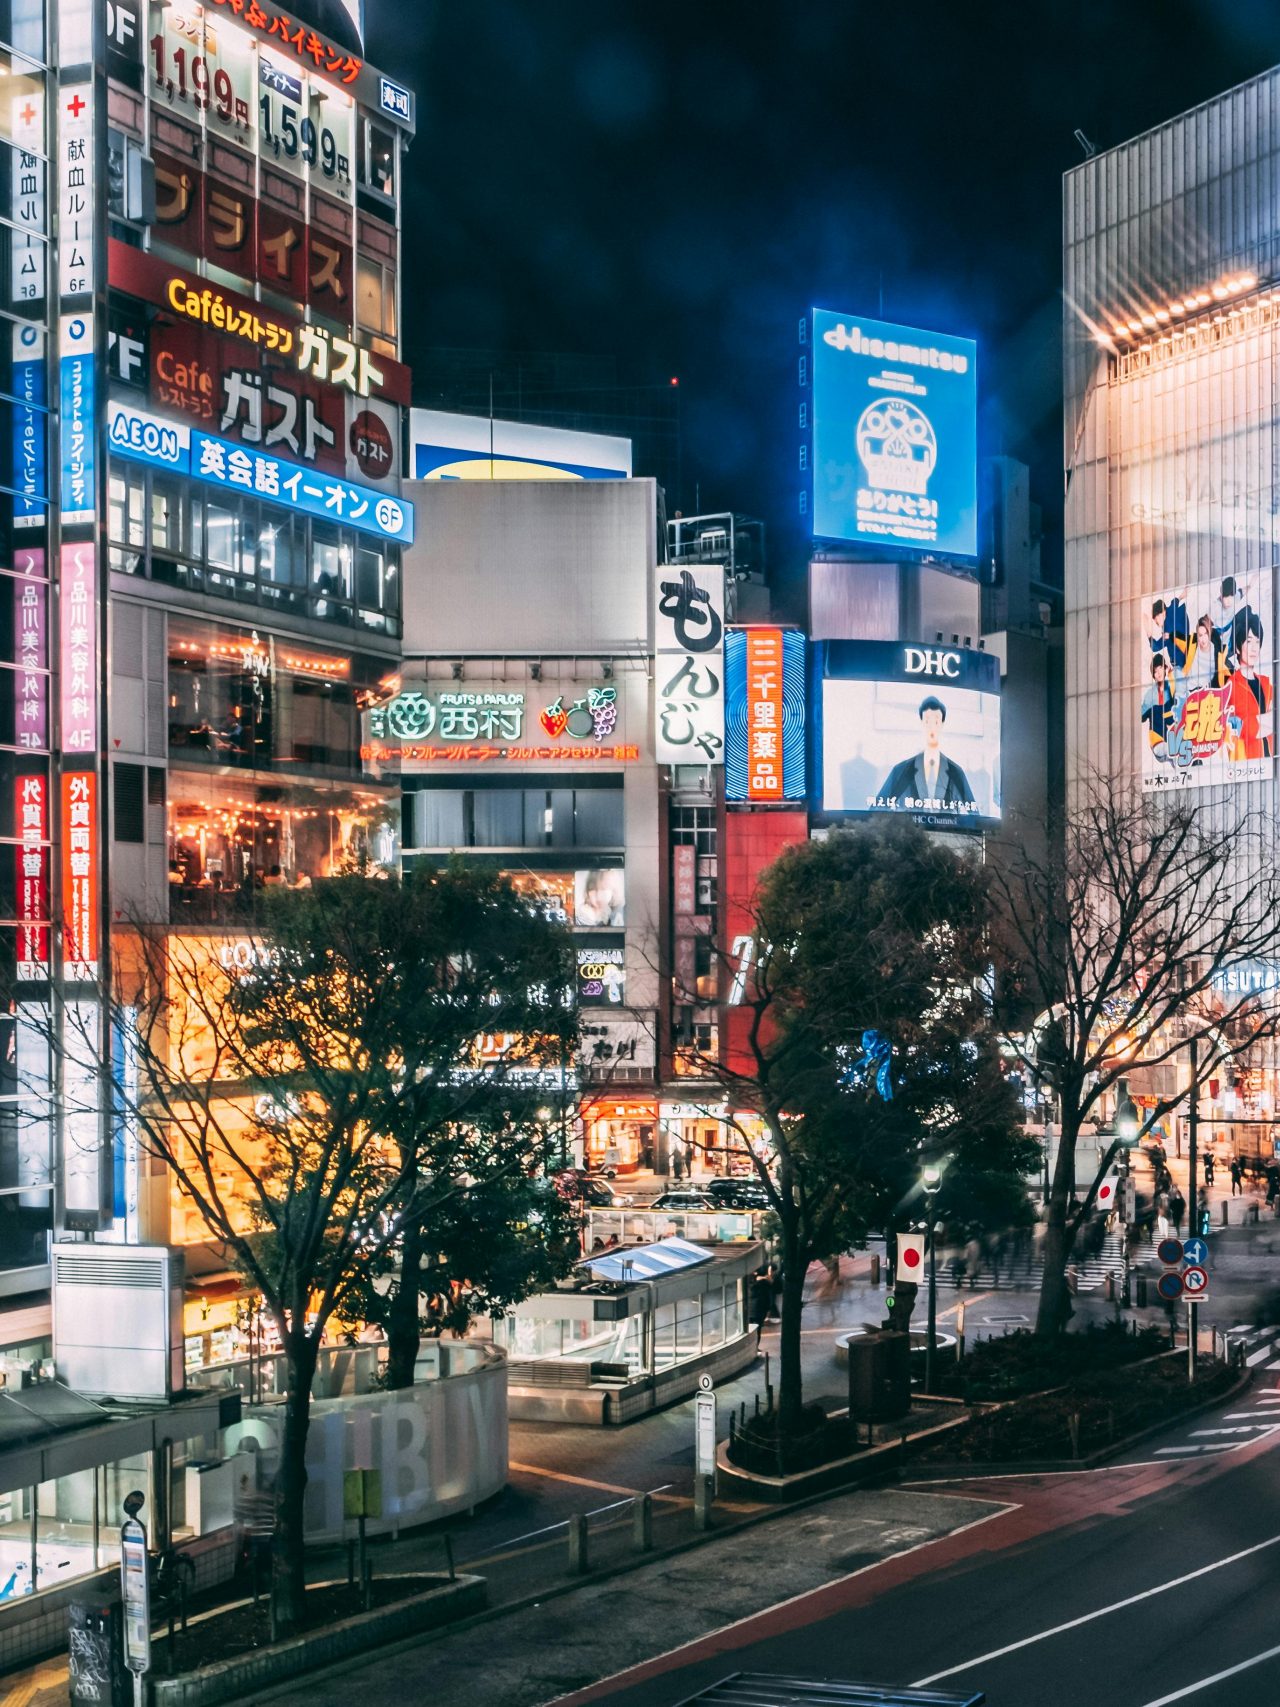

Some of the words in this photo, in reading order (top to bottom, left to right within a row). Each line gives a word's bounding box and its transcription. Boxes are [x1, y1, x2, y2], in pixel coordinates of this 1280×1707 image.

[212, 0, 363, 84] ゃぶバイキング
[383, 85, 409, 116] 寿司
[67, 140, 86, 267] 献血ルーム
[69, 278, 86, 292] 6F
[108, 331, 145, 380] F
[156, 351, 214, 397] Café
[297, 324, 385, 397] ガスト
[823, 323, 968, 374] Hisamitsu
[112, 412, 177, 456] AEON
[220, 370, 336, 460] ガスト
[357, 437, 389, 462] ガスト
[199, 438, 370, 519] 英会話イーオン
[379, 505, 399, 527] 6F
[70, 581, 89, 720] 品川美容外科
[658, 569, 724, 760] もんじゃ
[904, 648, 961, 678] DHC
[69, 730, 92, 748] 4F
[440, 706, 524, 740] 西村
[751, 638, 778, 790] 三千里薬品
[1183, 690, 1225, 743] 魂
[69, 776, 91, 877] 外貨両替
